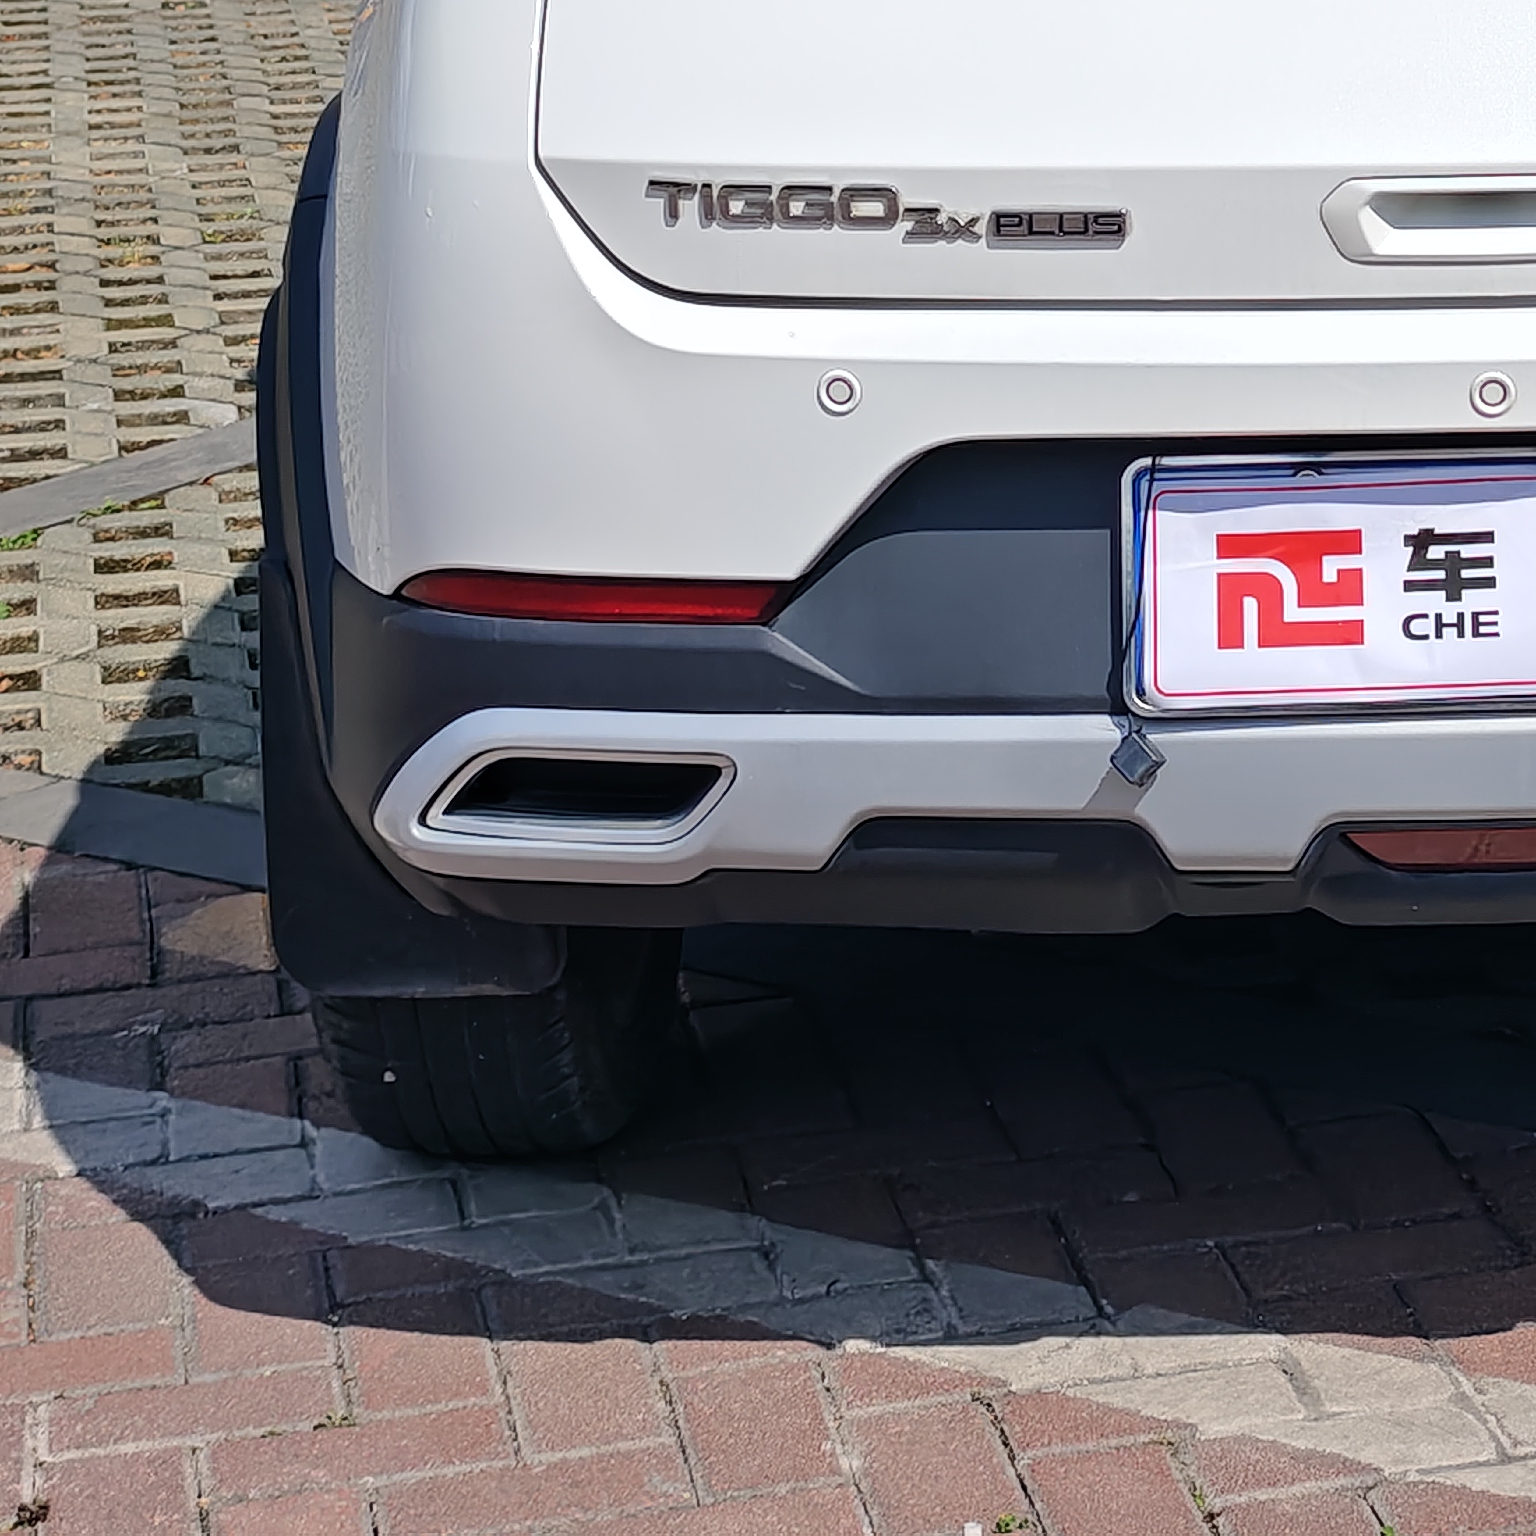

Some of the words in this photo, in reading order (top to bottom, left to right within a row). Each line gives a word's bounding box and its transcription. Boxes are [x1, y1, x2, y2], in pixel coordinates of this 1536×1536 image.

[645, 180, 899, 230] TIGGO
[993, 209, 1128, 239] PLUS
[1403, 611, 1499, 641] CHE
